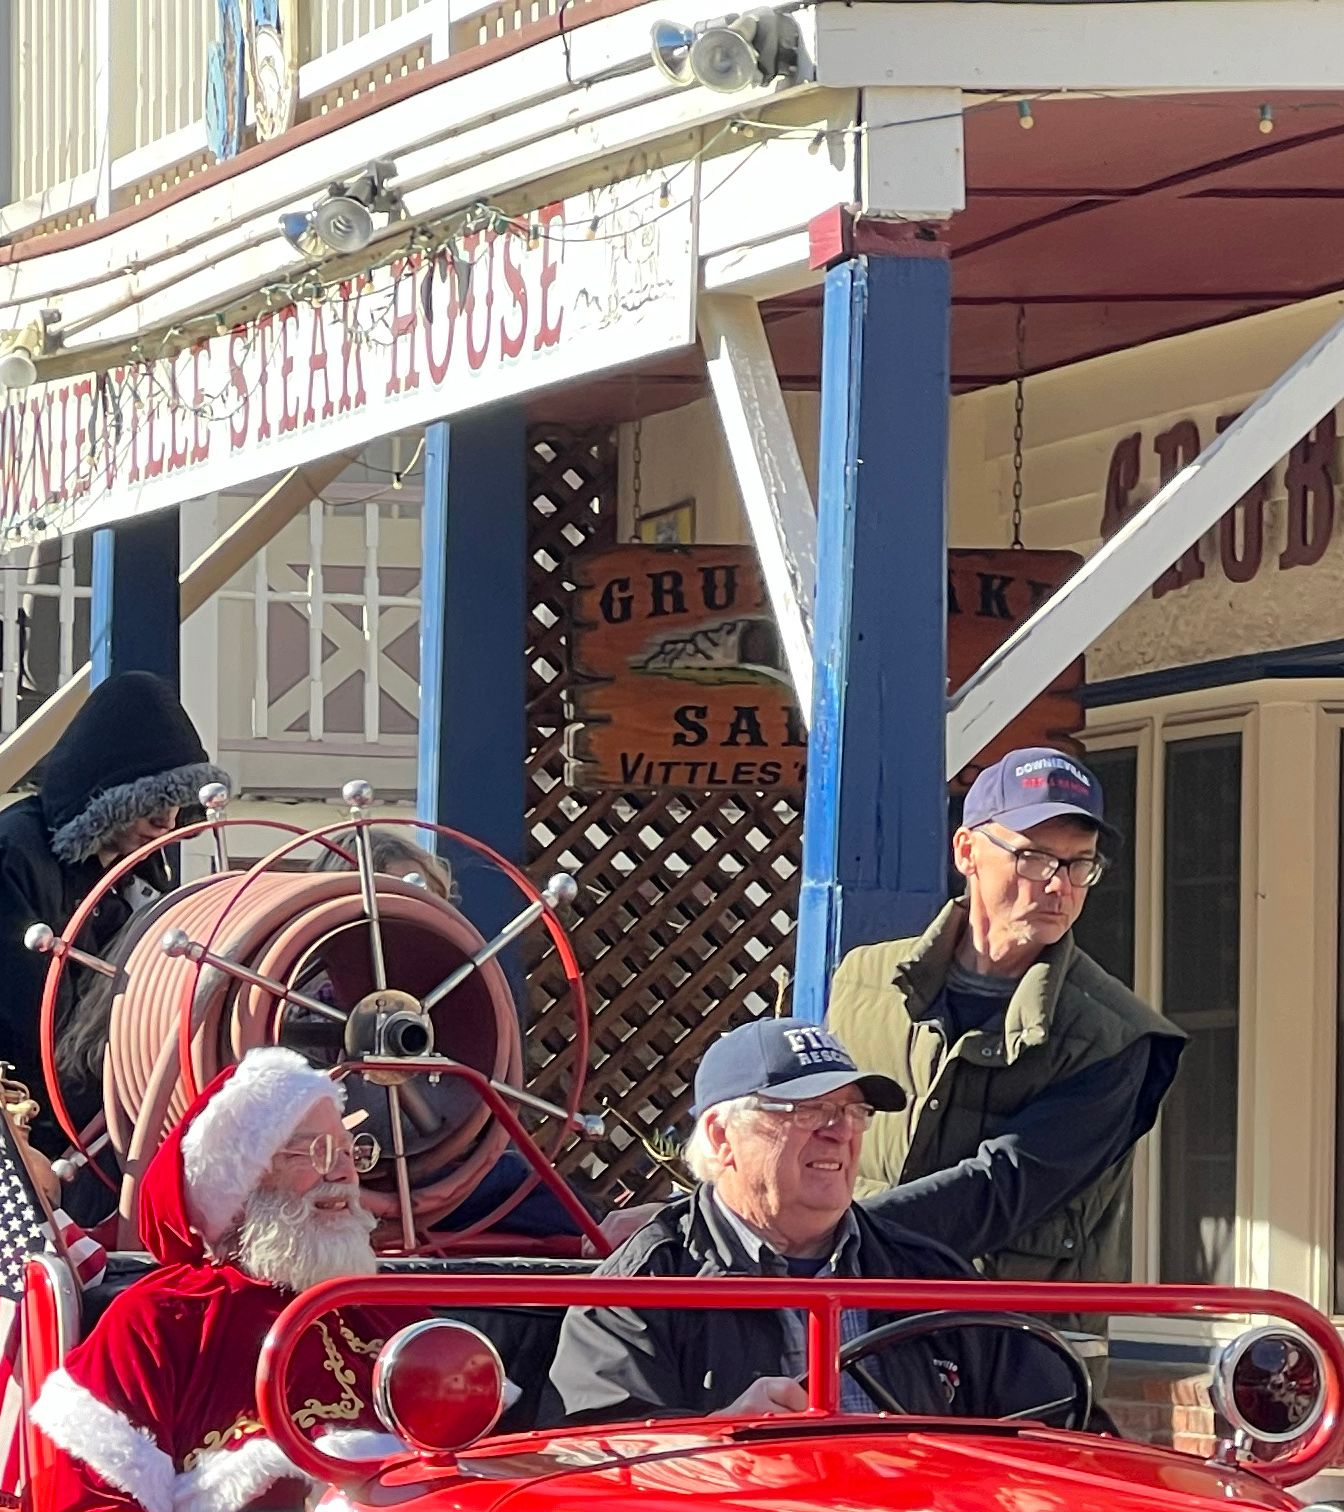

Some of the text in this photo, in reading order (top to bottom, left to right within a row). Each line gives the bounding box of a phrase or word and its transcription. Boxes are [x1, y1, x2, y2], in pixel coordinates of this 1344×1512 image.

[229, 275, 367, 450] STEAK
[384, 200, 565, 397] HOUSE
[618, 751, 782, 788] VITTLES
